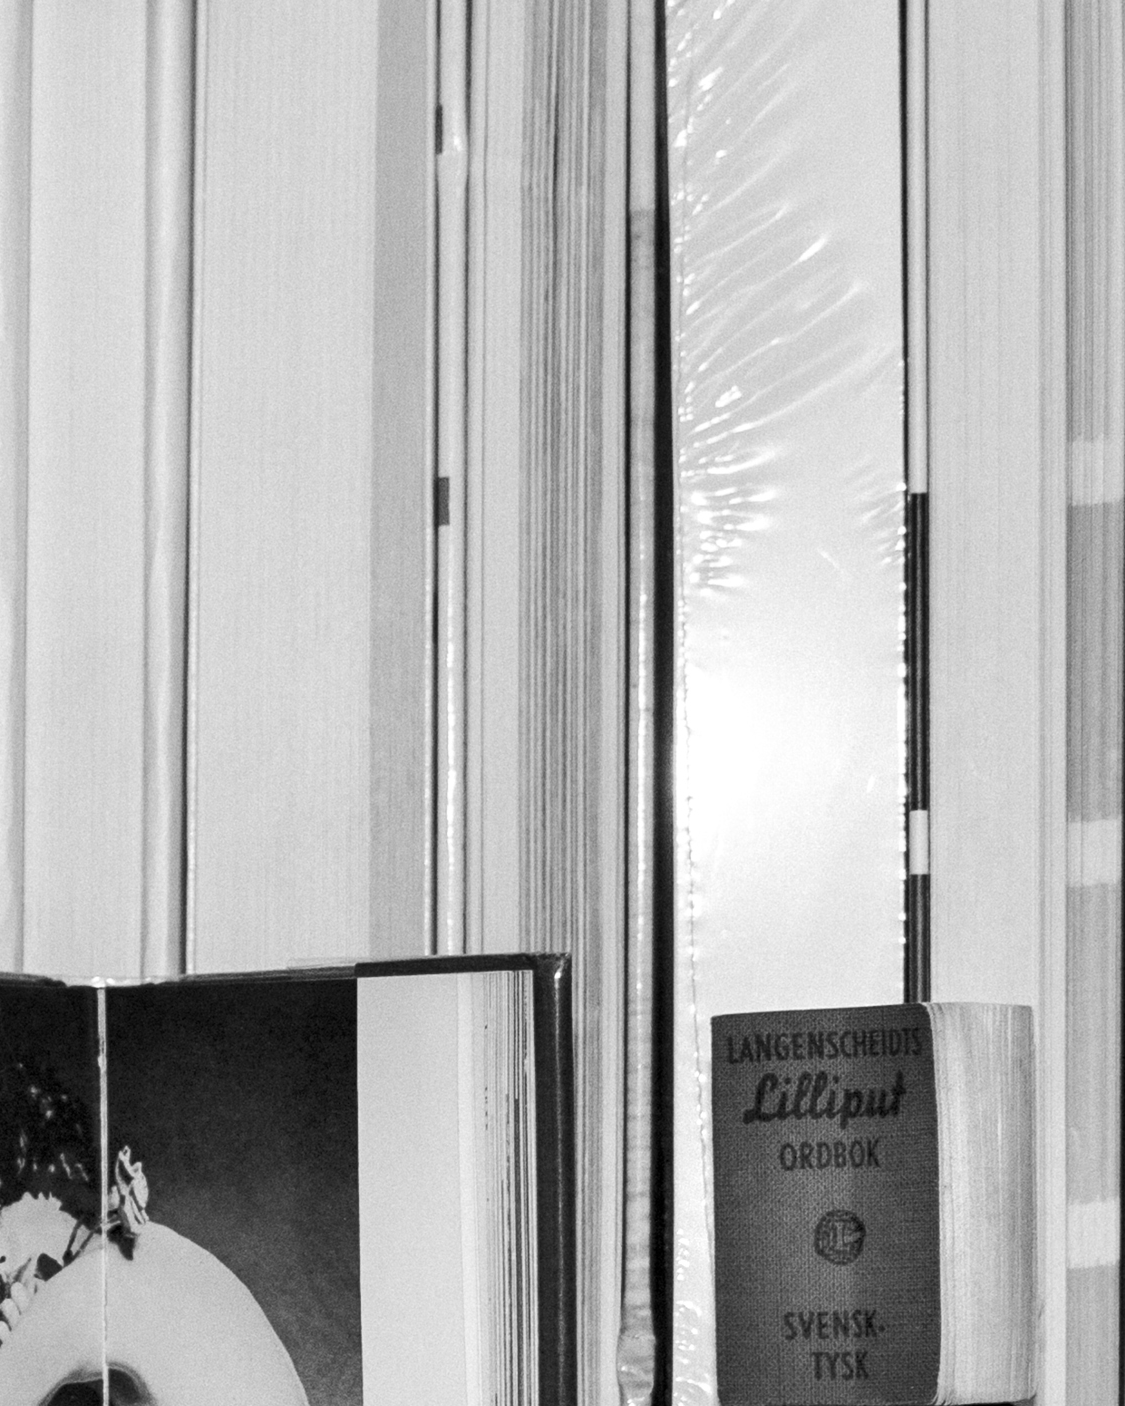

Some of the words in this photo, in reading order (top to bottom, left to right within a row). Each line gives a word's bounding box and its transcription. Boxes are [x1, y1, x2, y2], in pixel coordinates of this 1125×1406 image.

[727, 1028, 923, 1064] LANGENSCHEIDTS
[742, 1069, 907, 1129] Lilliput
[779, 1138, 881, 1172] ORDBOK
[812, 1351, 869, 1381] TYSK
